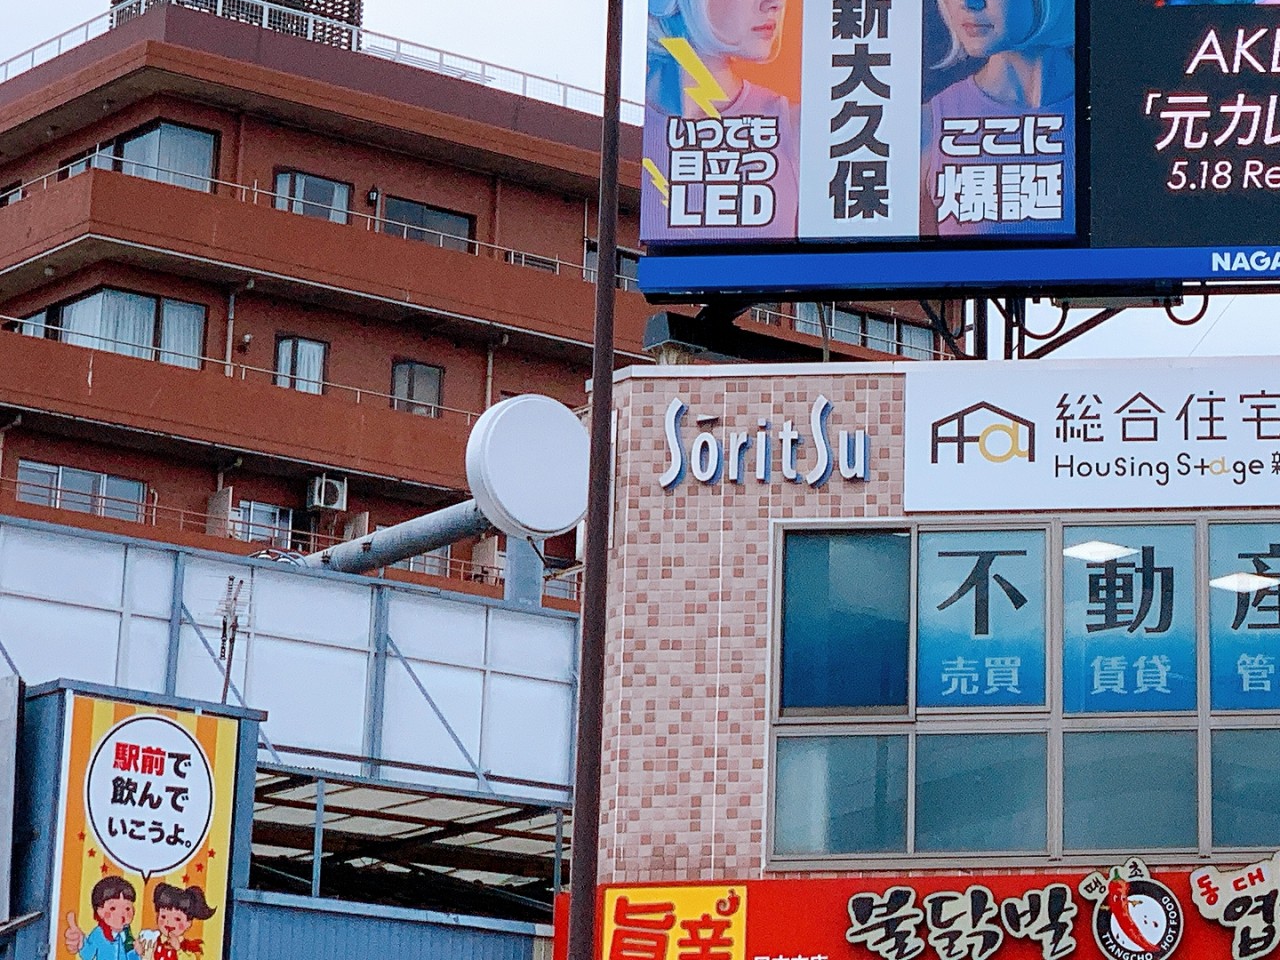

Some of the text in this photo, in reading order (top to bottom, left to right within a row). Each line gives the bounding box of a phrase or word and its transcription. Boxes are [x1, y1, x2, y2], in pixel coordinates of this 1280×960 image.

[668, 117, 779, 149] いつでも
[940, 116, 1064, 156] ここに
[670, 151, 777, 183] 目立つ
[1166, 160, 1233, 190] 5.18
[670, 184, 774, 226] LED
[937, 164, 1063, 222] 爆誕
[941, 655, 1022, 695] 売買
[1089, 654, 1171, 694] 賃貸
[113, 742, 192, 778] 駅前で
[110, 776, 189, 813] 飲んで
[107, 816, 192, 848] いこうよ。
[1161, 896, 1178, 951] HOT FOOD
[1101, 931, 1153, 960] TTANGCHO
